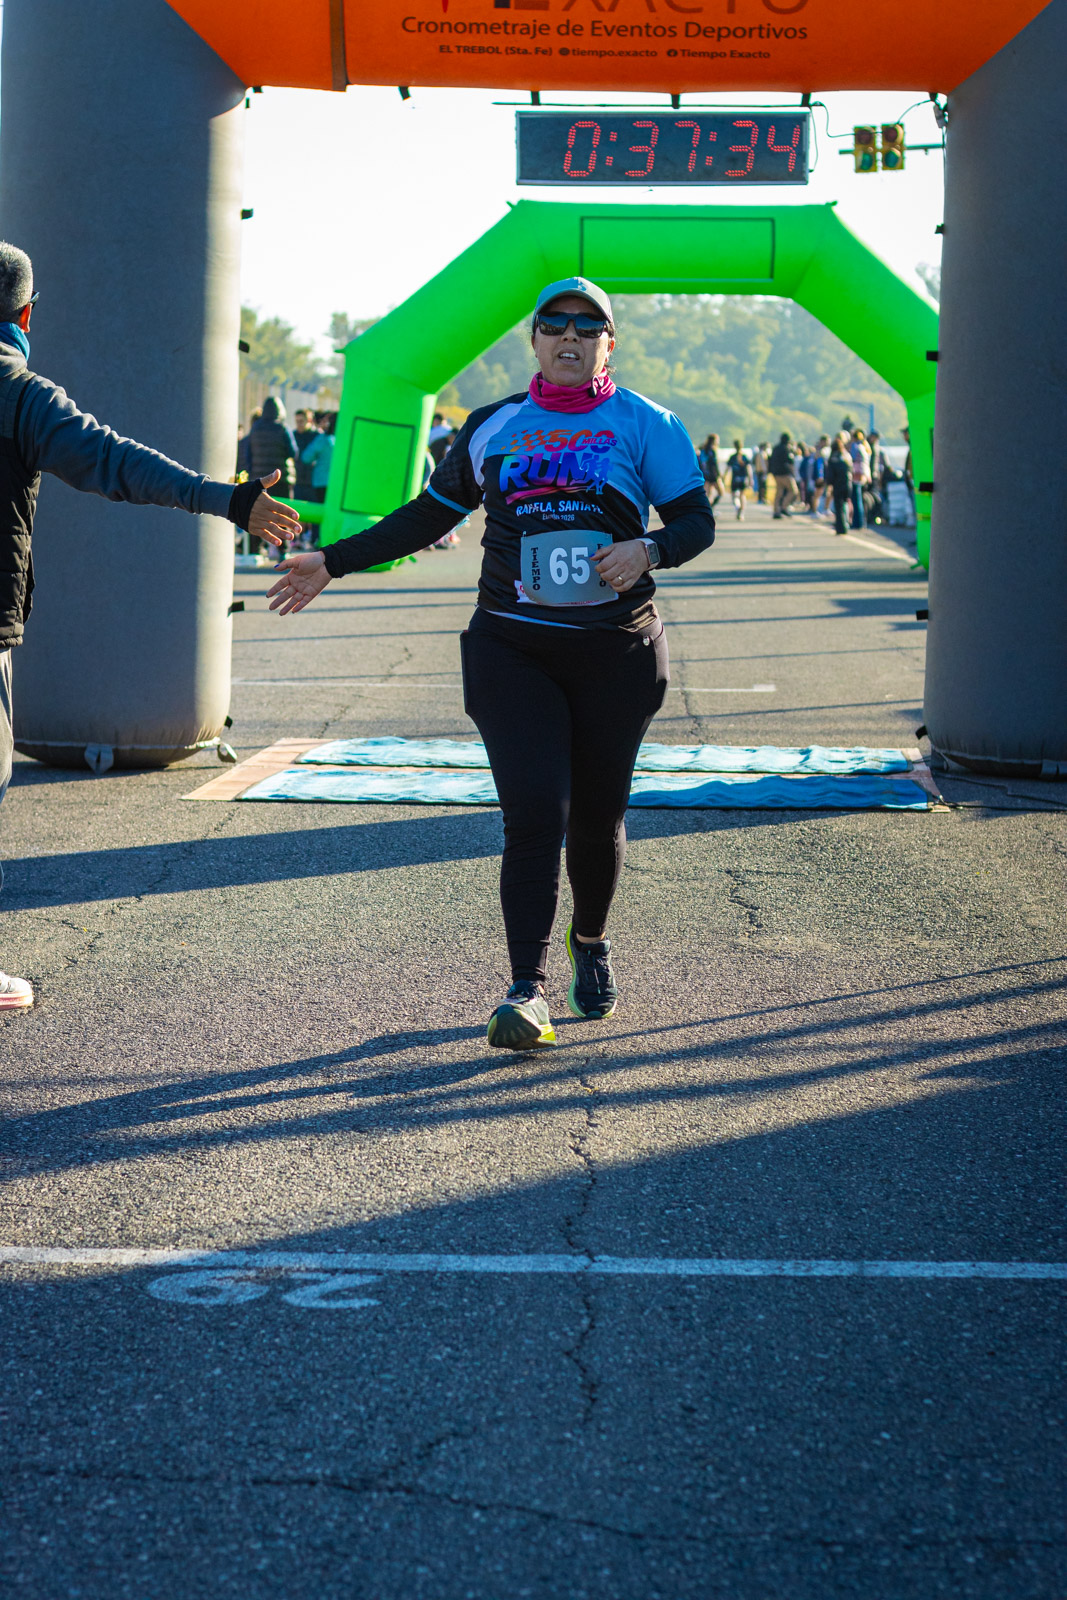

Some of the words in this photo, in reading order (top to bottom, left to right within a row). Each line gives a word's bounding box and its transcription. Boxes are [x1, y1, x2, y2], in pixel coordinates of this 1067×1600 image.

[401, 16, 550, 39] Cronometraje
[556, 19, 584, 36] de
[591, 20, 677, 38] Eventos
[684, 21, 808, 42] Deportivos
[439, 45, 453, 54] EL
[455, 45, 502, 55] TREBOL
[505, 46, 533, 56] (Sta.
[534, 47, 553, 56] Fe)
[571, 47, 658, 59] tiempo.exacto
[679, 49, 727, 60] Tiempo
[730, 50, 771, 60] Exacto
[563, 120, 801, 177] 0:37:34
[581, 437, 618, 447] MILLAS
[499, 452, 595, 493] RUN
[531, 547, 541, 591] TIEMPO
[549, 547, 590, 585] 65
